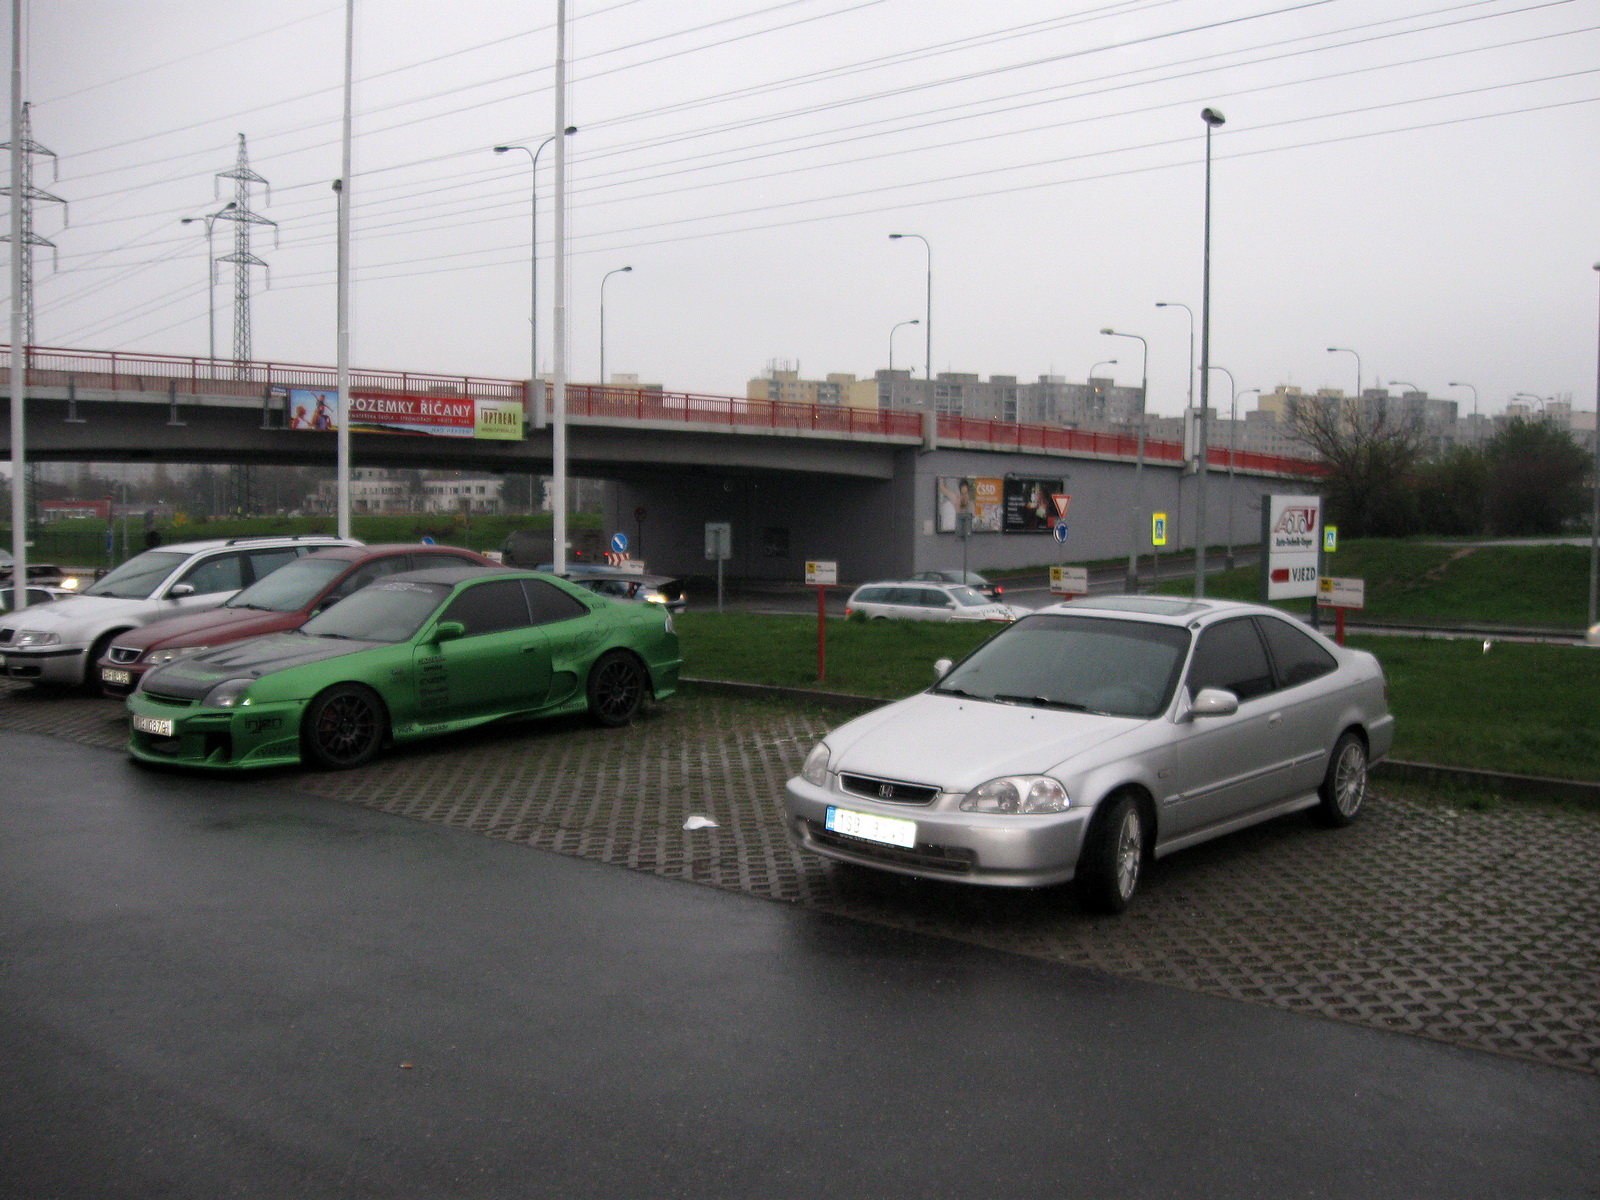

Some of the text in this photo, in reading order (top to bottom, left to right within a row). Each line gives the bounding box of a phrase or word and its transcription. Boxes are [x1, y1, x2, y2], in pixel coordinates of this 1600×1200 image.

[348, 397, 471, 416] POZEMKY ŘÍČANY
[483, 411, 516, 425] OPTREAL
[1292, 567, 1316, 582] VJEZD
